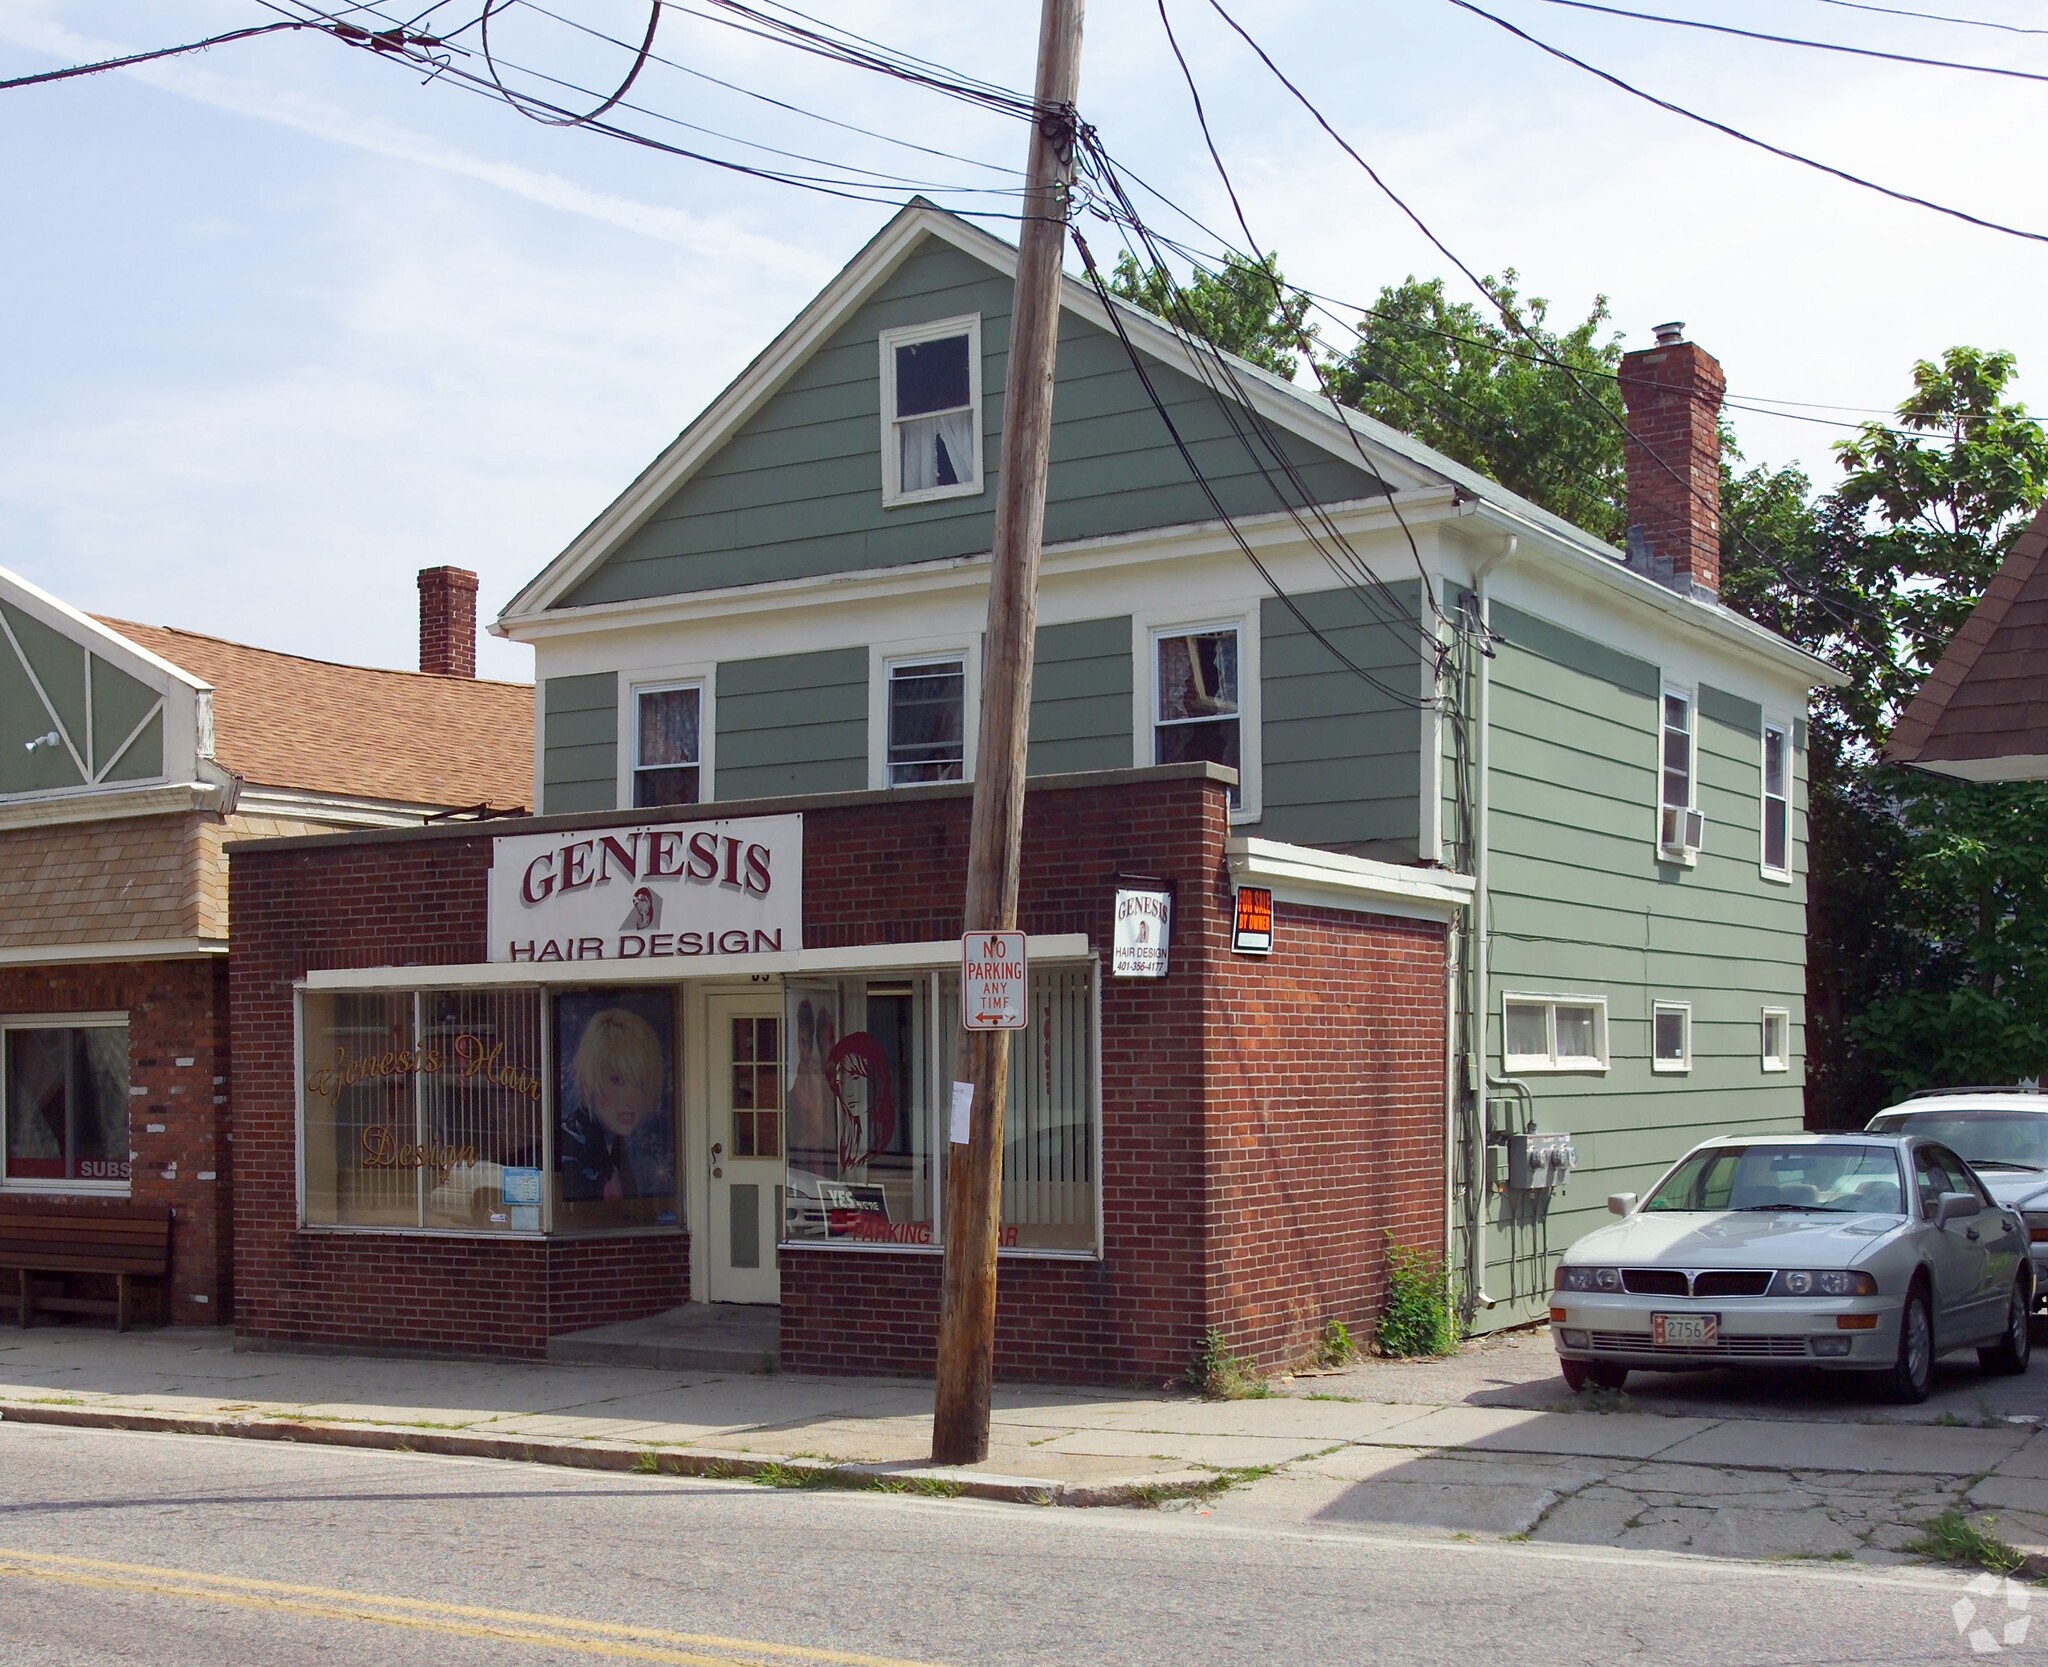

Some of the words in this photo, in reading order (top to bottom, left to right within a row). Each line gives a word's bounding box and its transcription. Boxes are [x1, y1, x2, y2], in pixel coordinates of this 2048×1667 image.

[522, 830, 771, 904] GENESIS
[1118, 896, 1169, 924] GENESIS
[1239, 889, 1253, 913] FOR
[1254, 890, 1271, 915] SALE
[1238, 913, 1249, 929] BY
[1249, 914, 1271, 930] OWNER
[509, 937, 605, 962] HAIR
[617, 928, 782, 957] DESIGN
[983, 940, 1006, 959] NO
[1115, 947, 1136, 958] HAIR
[1137, 947, 1168, 959] DESIGN
[968, 962, 1022, 980] PARKING
[1117, 961, 1164, 972] 401-356-4177
[983, 982, 1007, 995] ANY
[308, 1041, 444, 1107] Genesis
[454, 1034, 541, 1101] Hair
[361, 1122, 478, 1185] Design
[80, 1160, 130, 1178] SUBS
[828, 1189, 856, 1209] YES
[852, 1220, 932, 1245] PARKING
[1668, 1322, 1702, 1338] 2756
